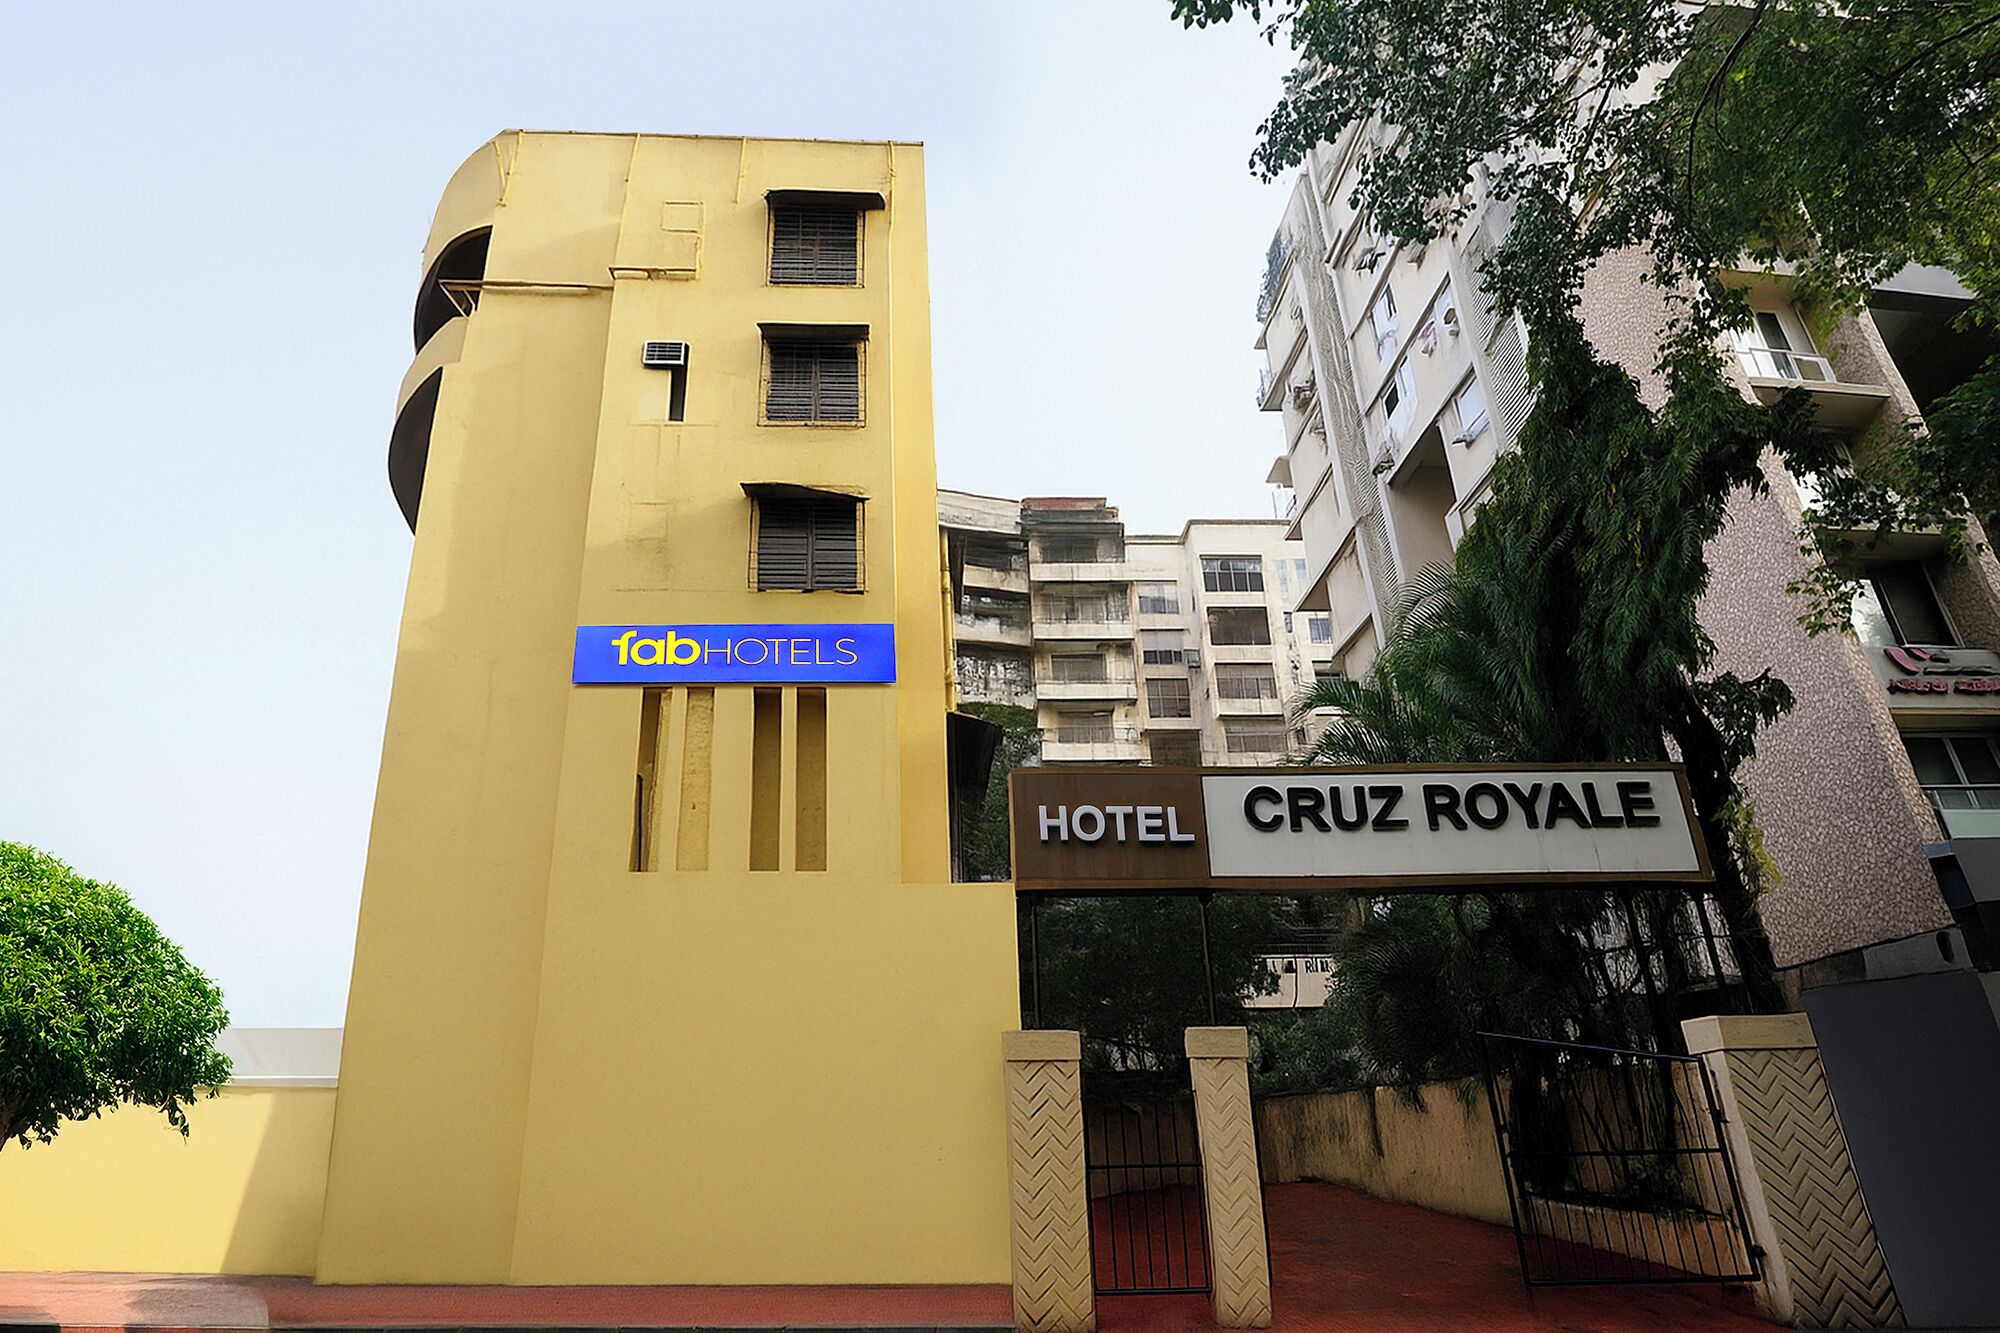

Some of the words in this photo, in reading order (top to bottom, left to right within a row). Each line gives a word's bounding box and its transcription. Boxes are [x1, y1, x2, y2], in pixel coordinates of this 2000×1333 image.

[611, 630, 858, 666] fabHOTELS
[1038, 804, 1196, 843] HOTEL
[1242, 784, 1410, 832] CRUZ
[1422, 781, 1661, 831] ROYALE
